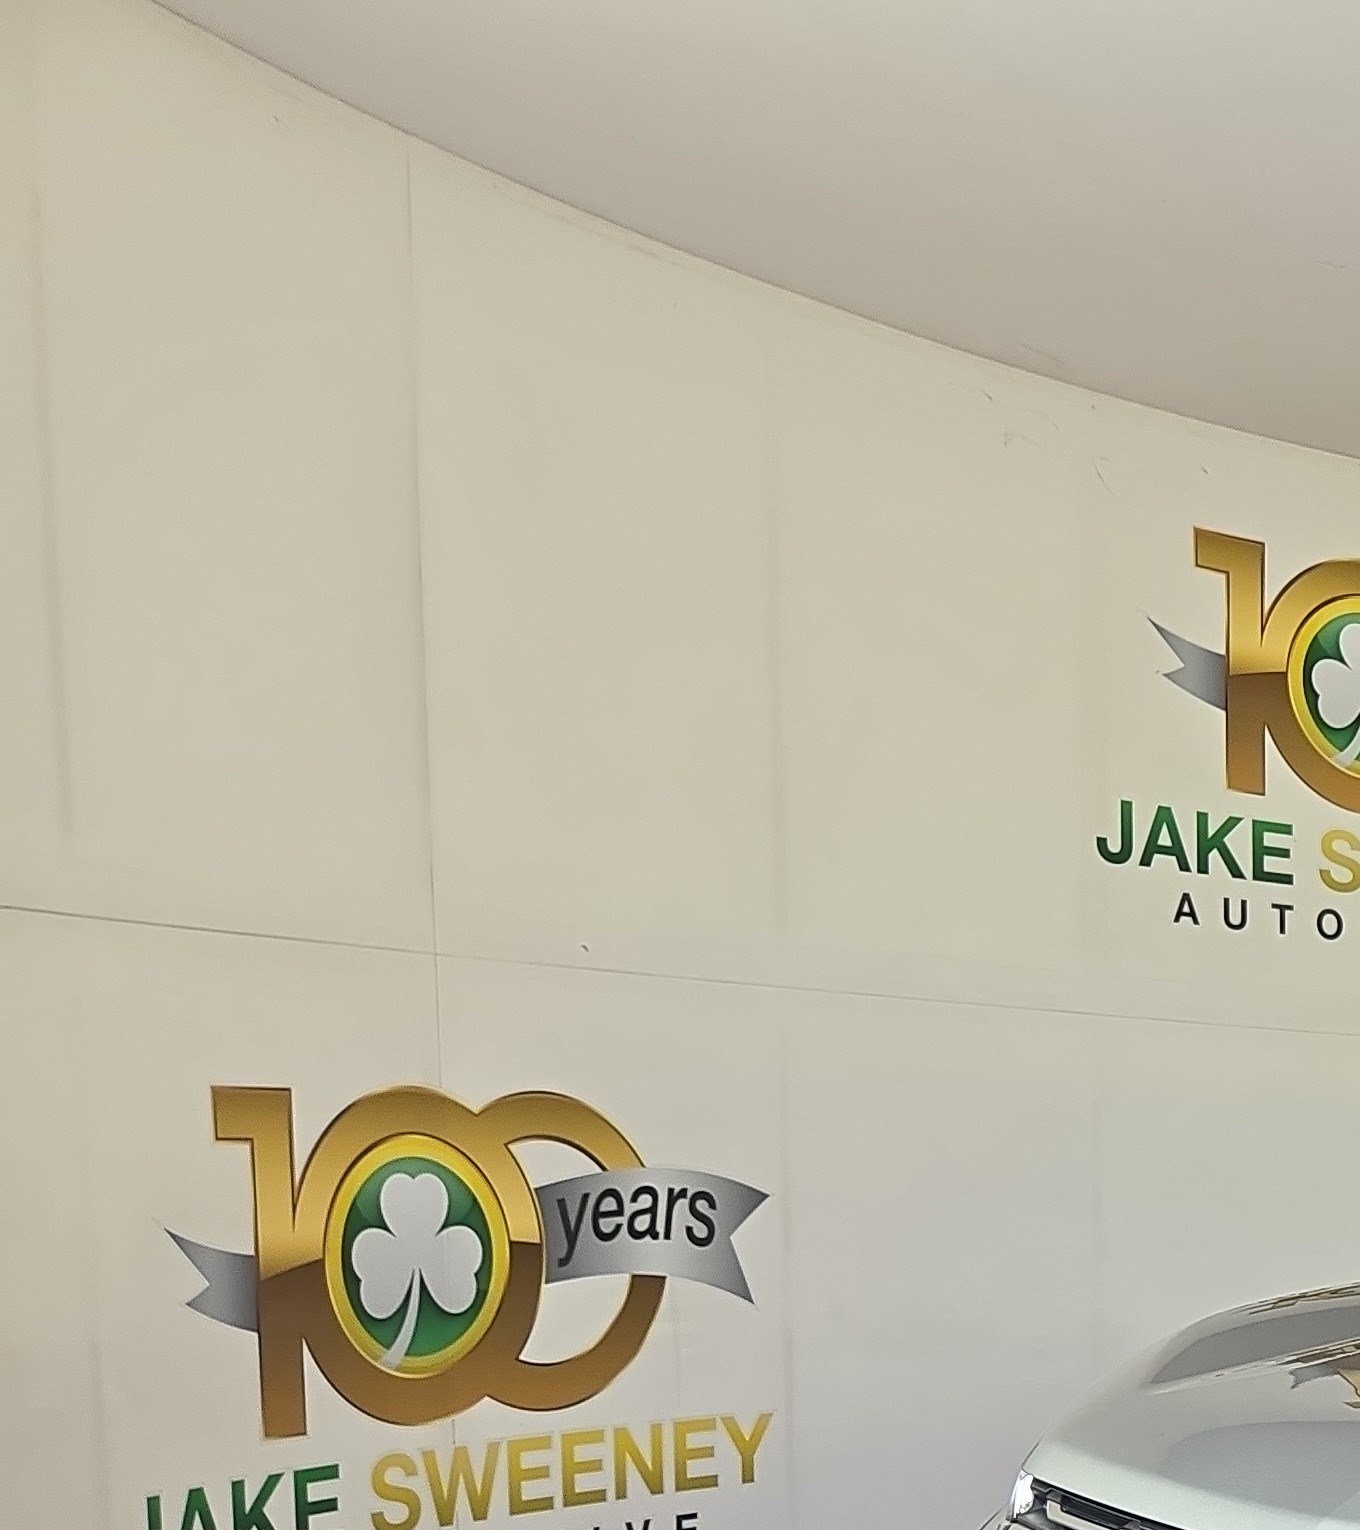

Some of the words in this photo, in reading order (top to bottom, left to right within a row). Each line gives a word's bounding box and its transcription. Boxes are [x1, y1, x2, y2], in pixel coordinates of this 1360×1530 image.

[1095, 798, 1295, 886] JAKE
[211, 1085, 669, 1439] 100
[554, 1184, 718, 1268] years
